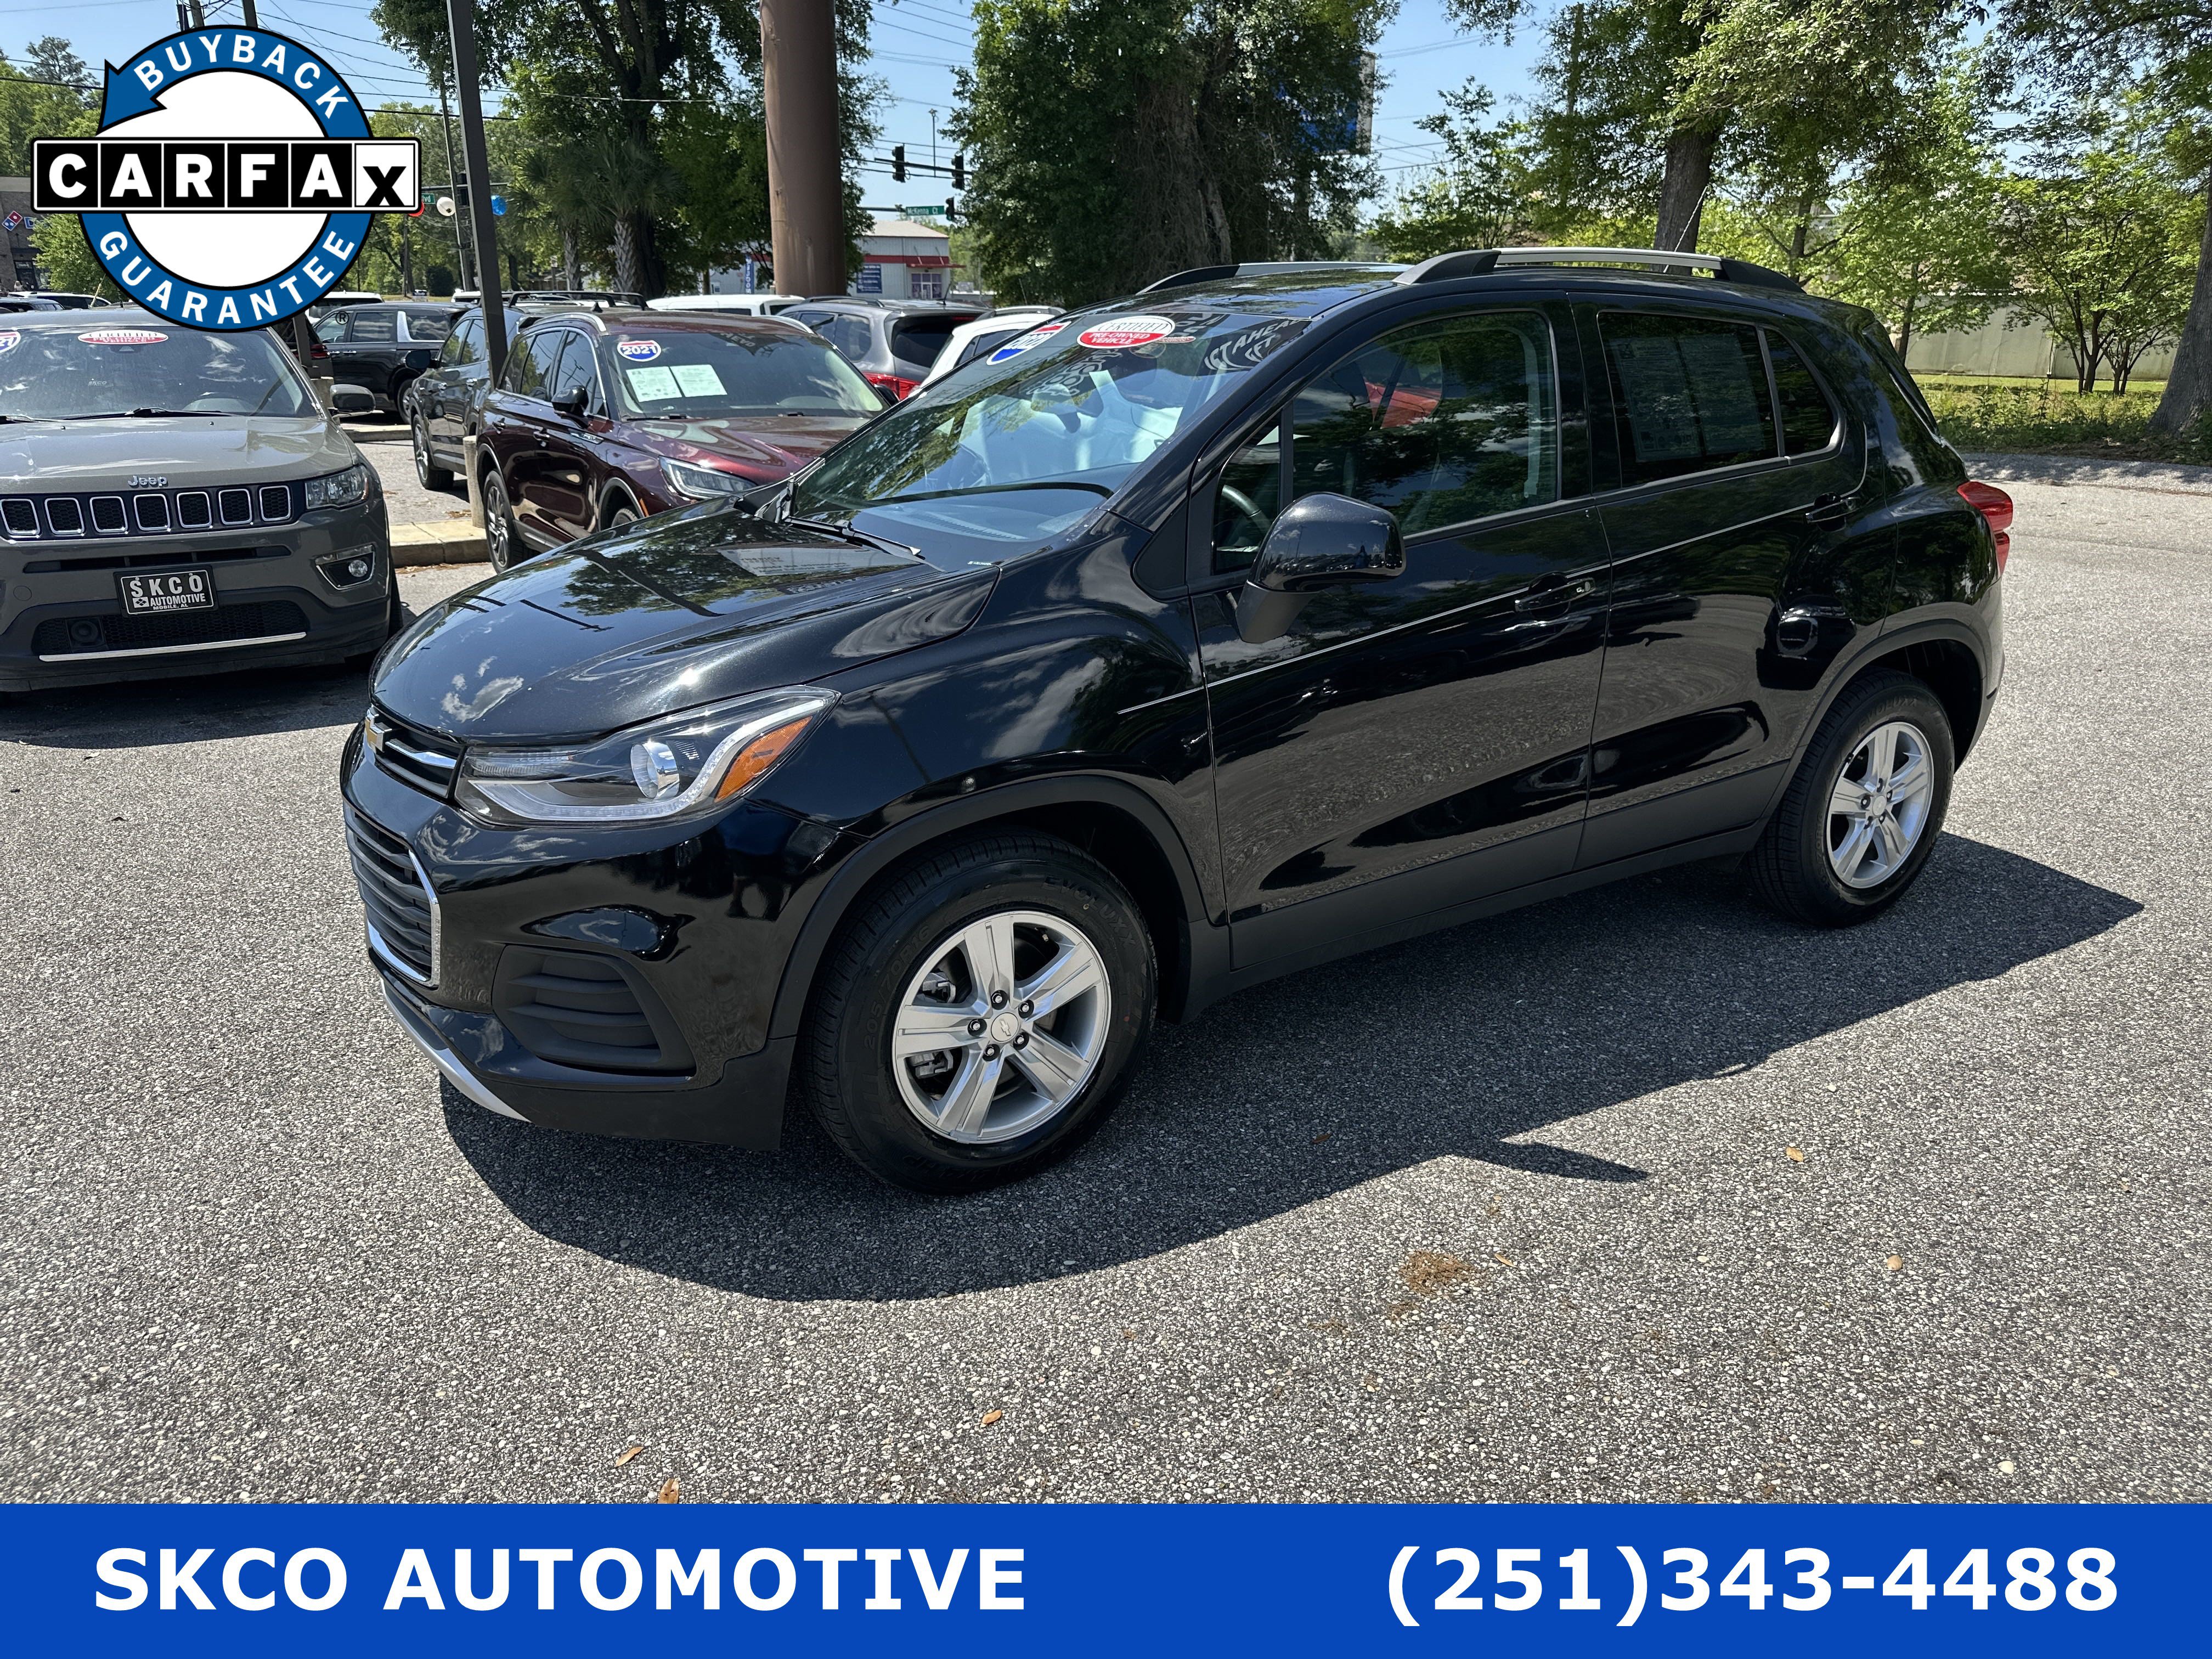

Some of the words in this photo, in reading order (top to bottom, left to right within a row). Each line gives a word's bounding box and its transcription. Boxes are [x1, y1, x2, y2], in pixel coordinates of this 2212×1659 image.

[1097, 322, 1169, 332] CERTIFIED
[622, 345, 657, 356] 2021
[127, 475, 167, 487] Jeep
[129, 574, 204, 598] SKCO
[150, 592, 206, 607] AUTOMOTIVE
[1041, 874, 1136, 949] EVOLUXX
[864, 924, 929, 1051] 205/70R16
